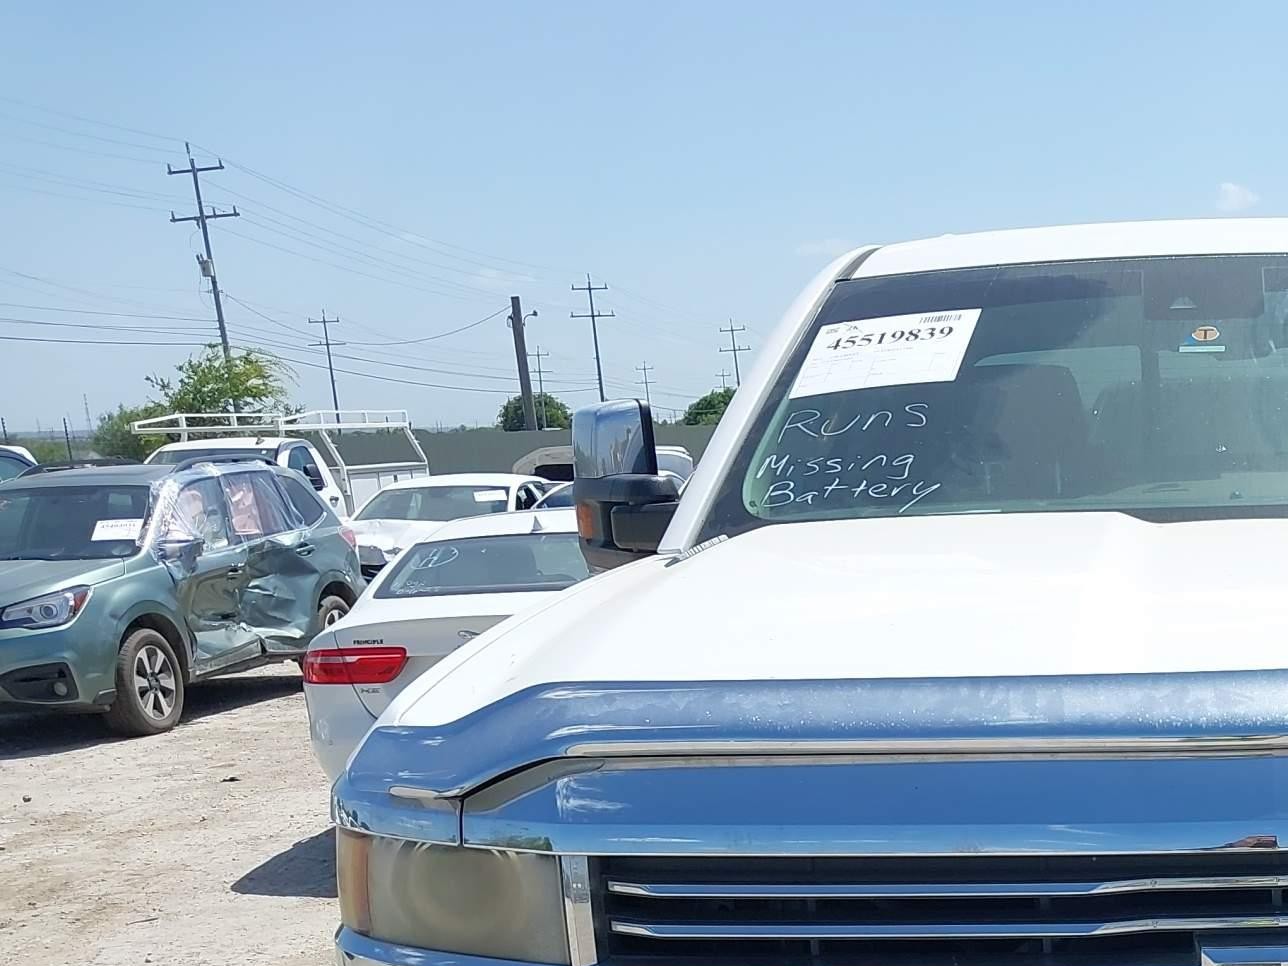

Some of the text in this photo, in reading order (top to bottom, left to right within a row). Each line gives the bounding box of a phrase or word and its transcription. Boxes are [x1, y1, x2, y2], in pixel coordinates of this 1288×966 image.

[826, 325, 954, 351] 45519839
[755, 453, 915, 480] Missing
[760, 477, 942, 514] Battery
